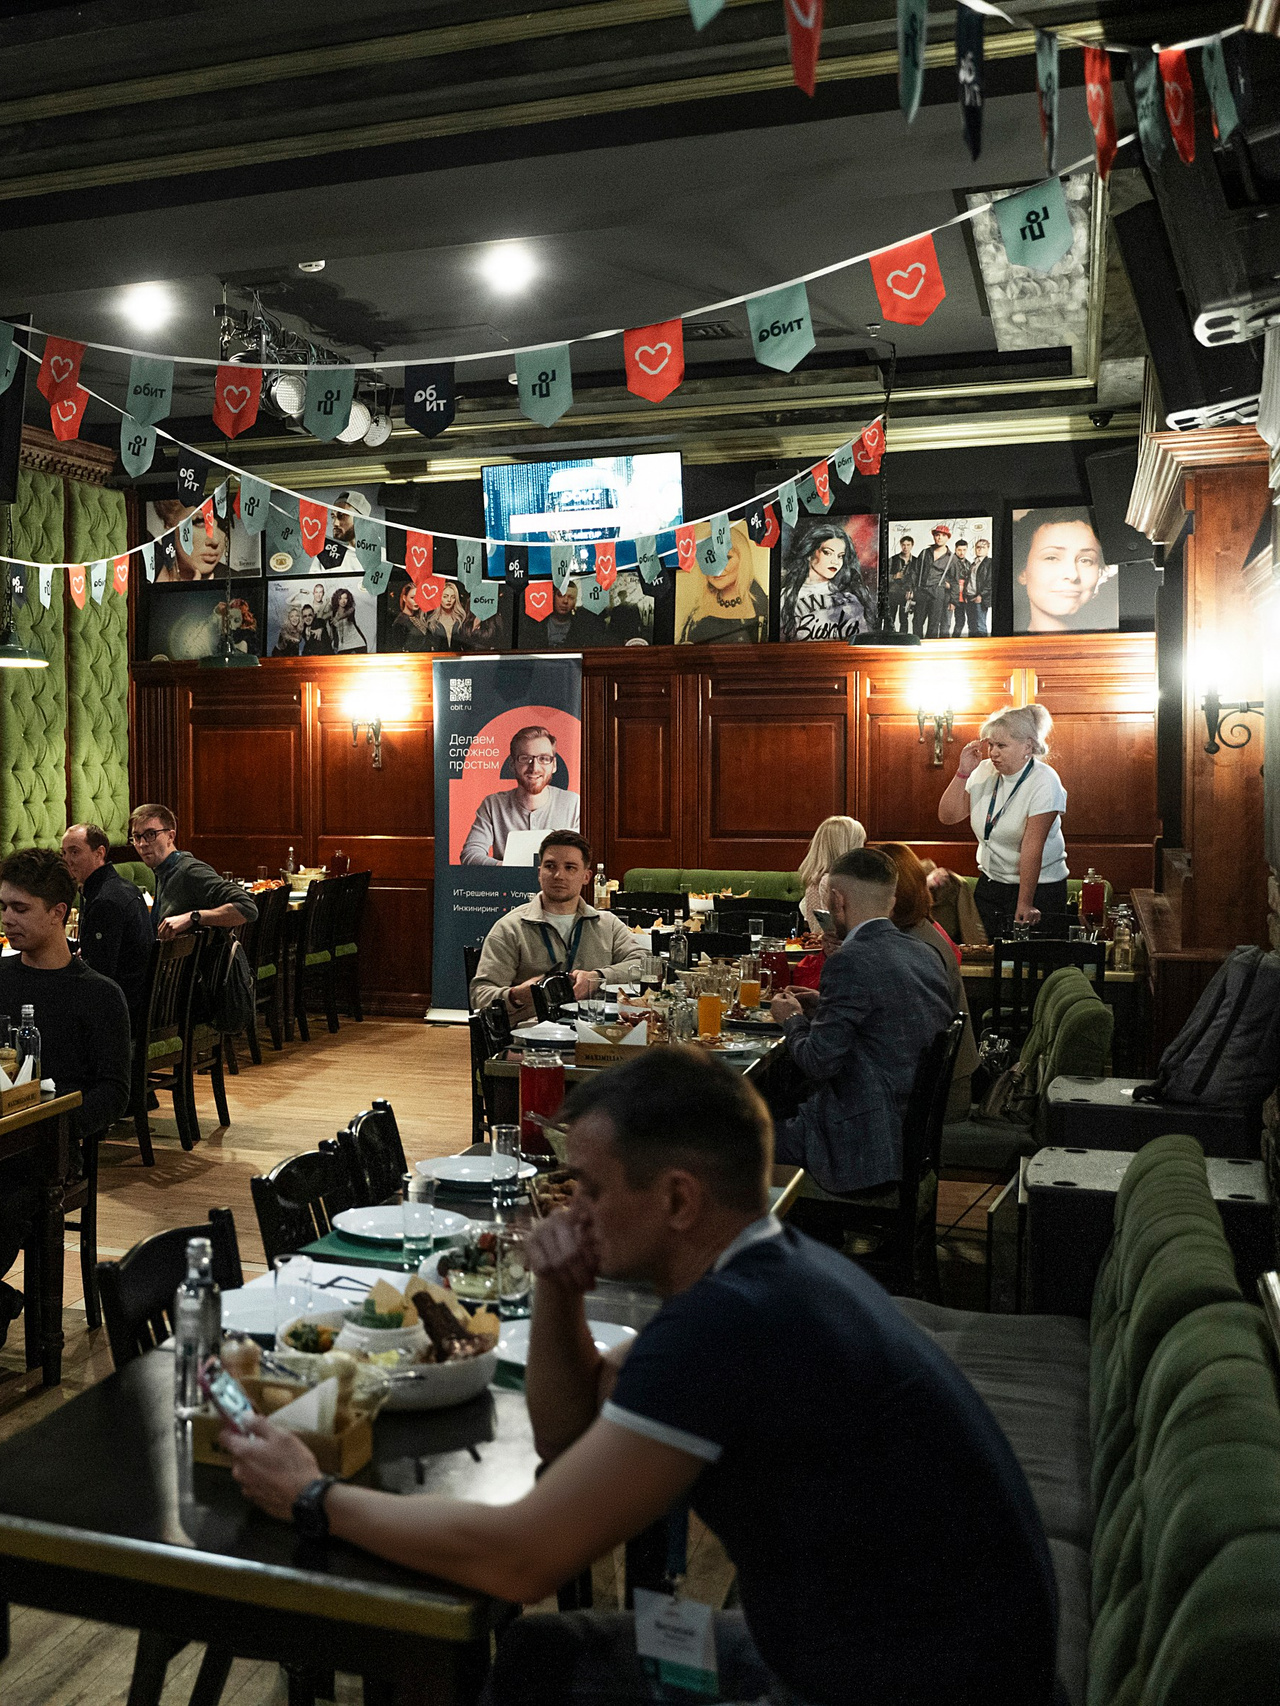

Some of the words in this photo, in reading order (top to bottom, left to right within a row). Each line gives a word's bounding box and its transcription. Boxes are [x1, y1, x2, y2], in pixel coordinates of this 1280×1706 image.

[758, 317, 804, 343] обит
[133, 382, 166, 398] обит
[449, 734, 495, 746] Делаем
[449, 748, 500, 757] сложное
[449, 760, 500, 772] простым
[453, 889, 500, 898] ИТ-решения
[453, 905, 500, 914] Инжиниринг
